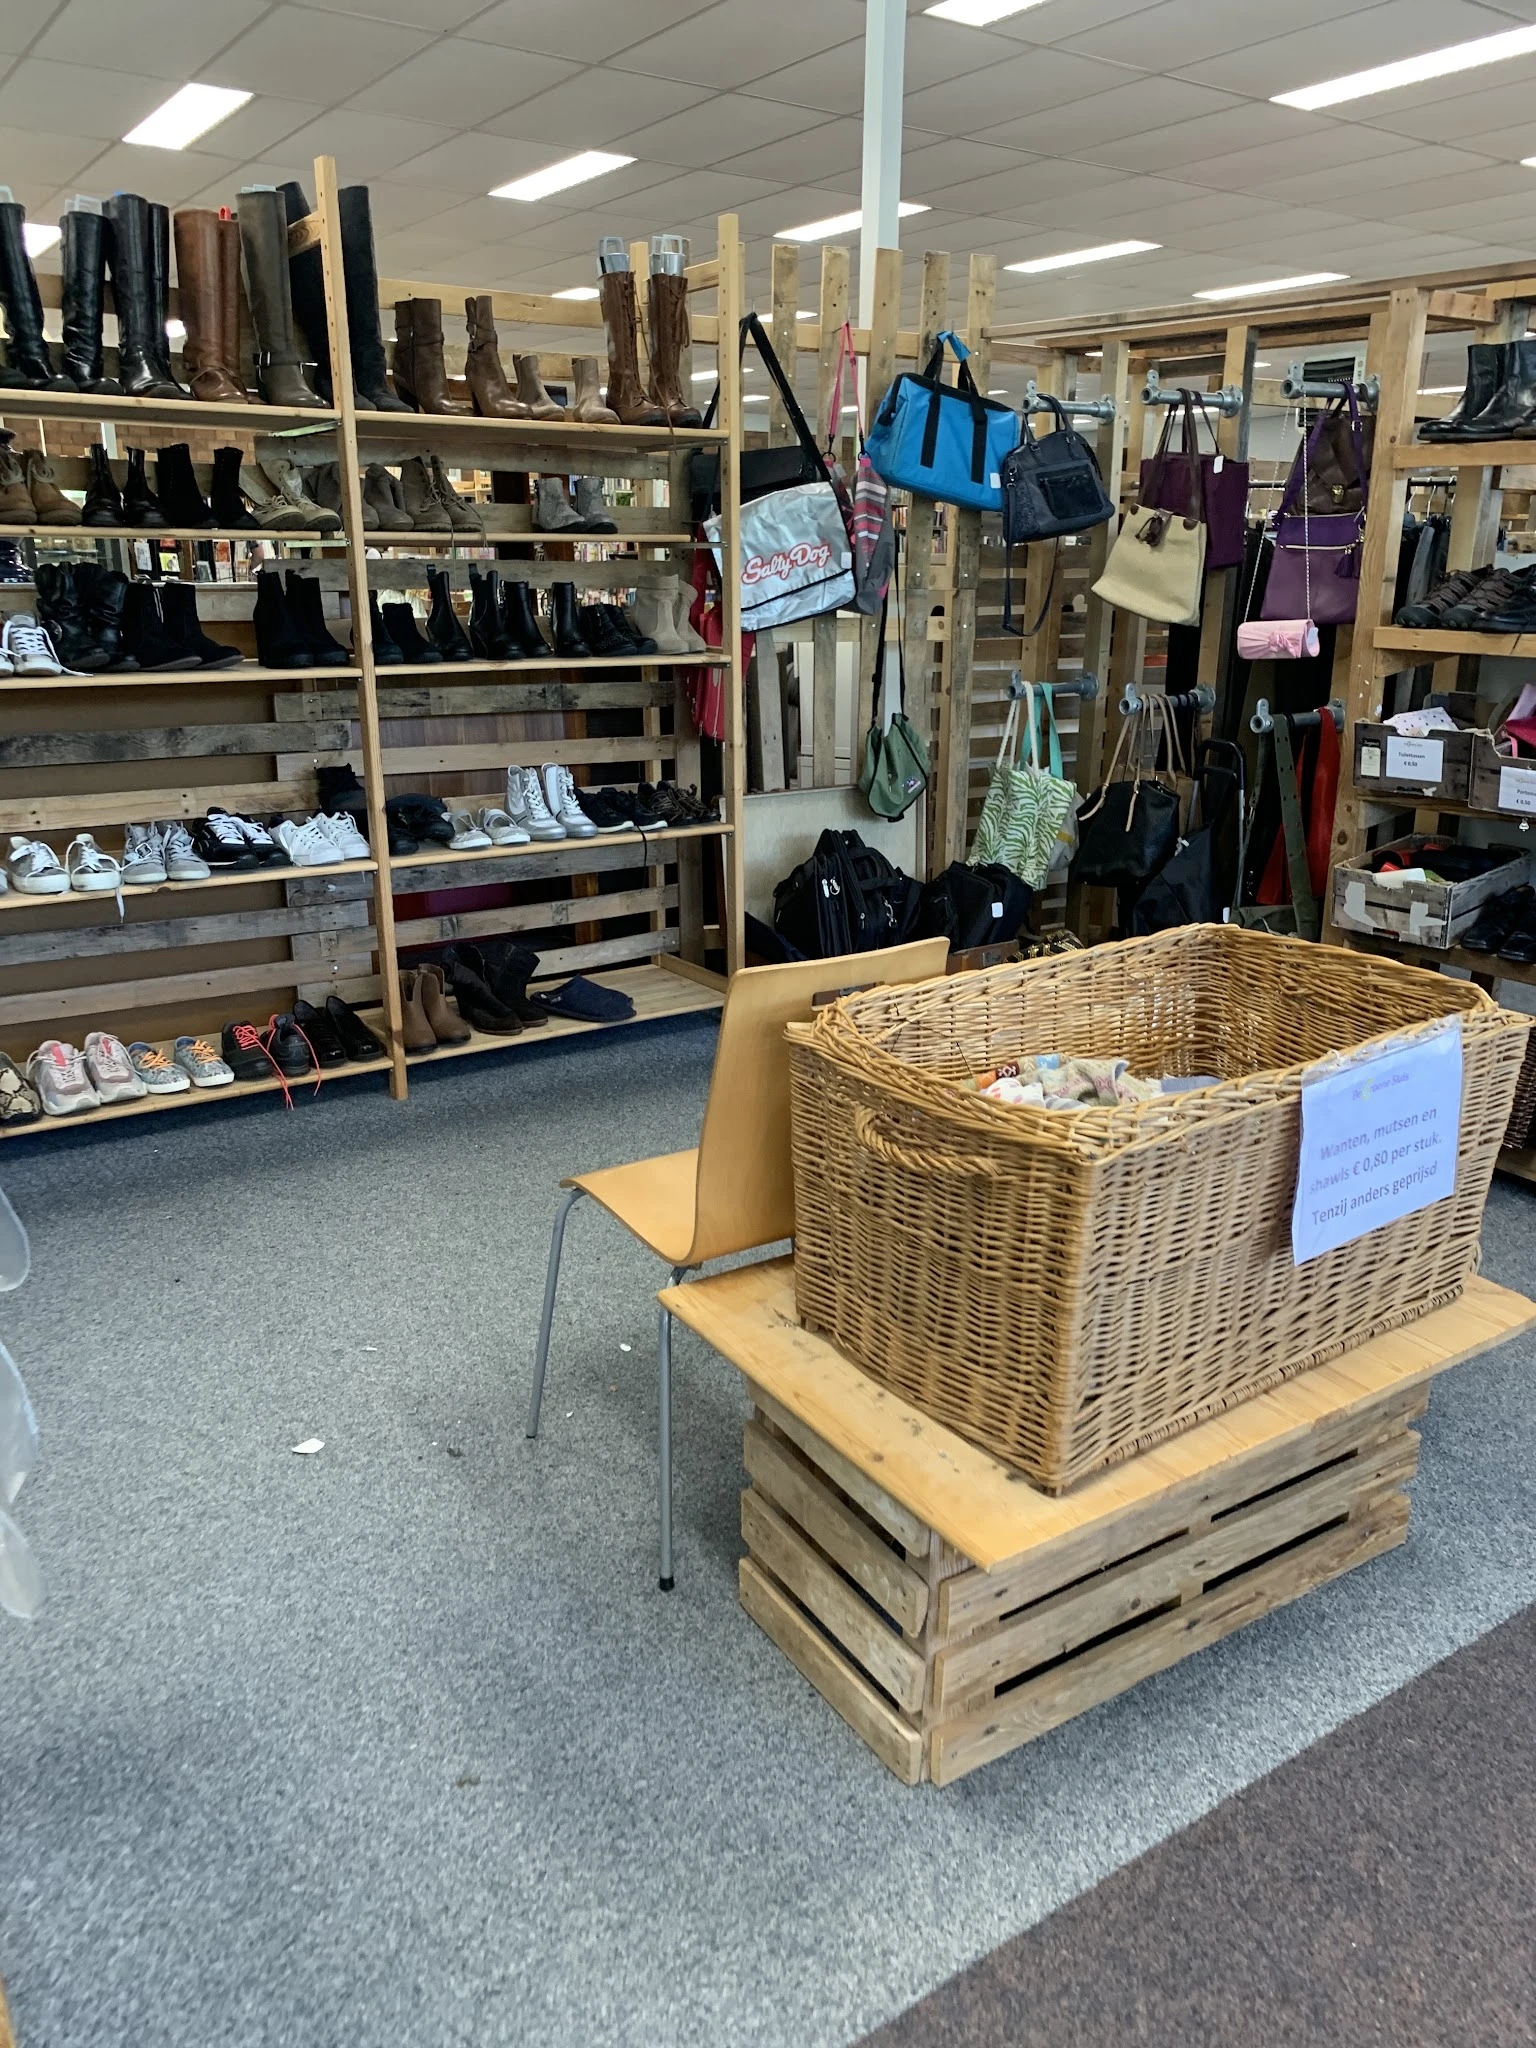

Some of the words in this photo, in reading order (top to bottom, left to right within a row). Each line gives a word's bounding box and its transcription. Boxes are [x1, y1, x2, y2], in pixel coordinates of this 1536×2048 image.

[741, 553, 791, 584] Salty
[790, 542, 832, 568] Dog
[1320, 1131, 1371, 1161] Wanten,
[1374, 1113, 1418, 1140] mutsen
[1421, 1107, 1437, 1122] en
[1309, 1165, 1350, 1195] shawls
[1352, 1161, 1361, 1176] €
[1362, 1151, 1389, 1174] 0,80
[1391, 1145, 1411, 1164] per
[1413, 1134, 1443, 1153] stuk.
[1311, 1197, 1348, 1226] Tenzij
[1350, 1182, 1390, 1210] anders
[1392, 1160, 1438, 1195] geprijsd
